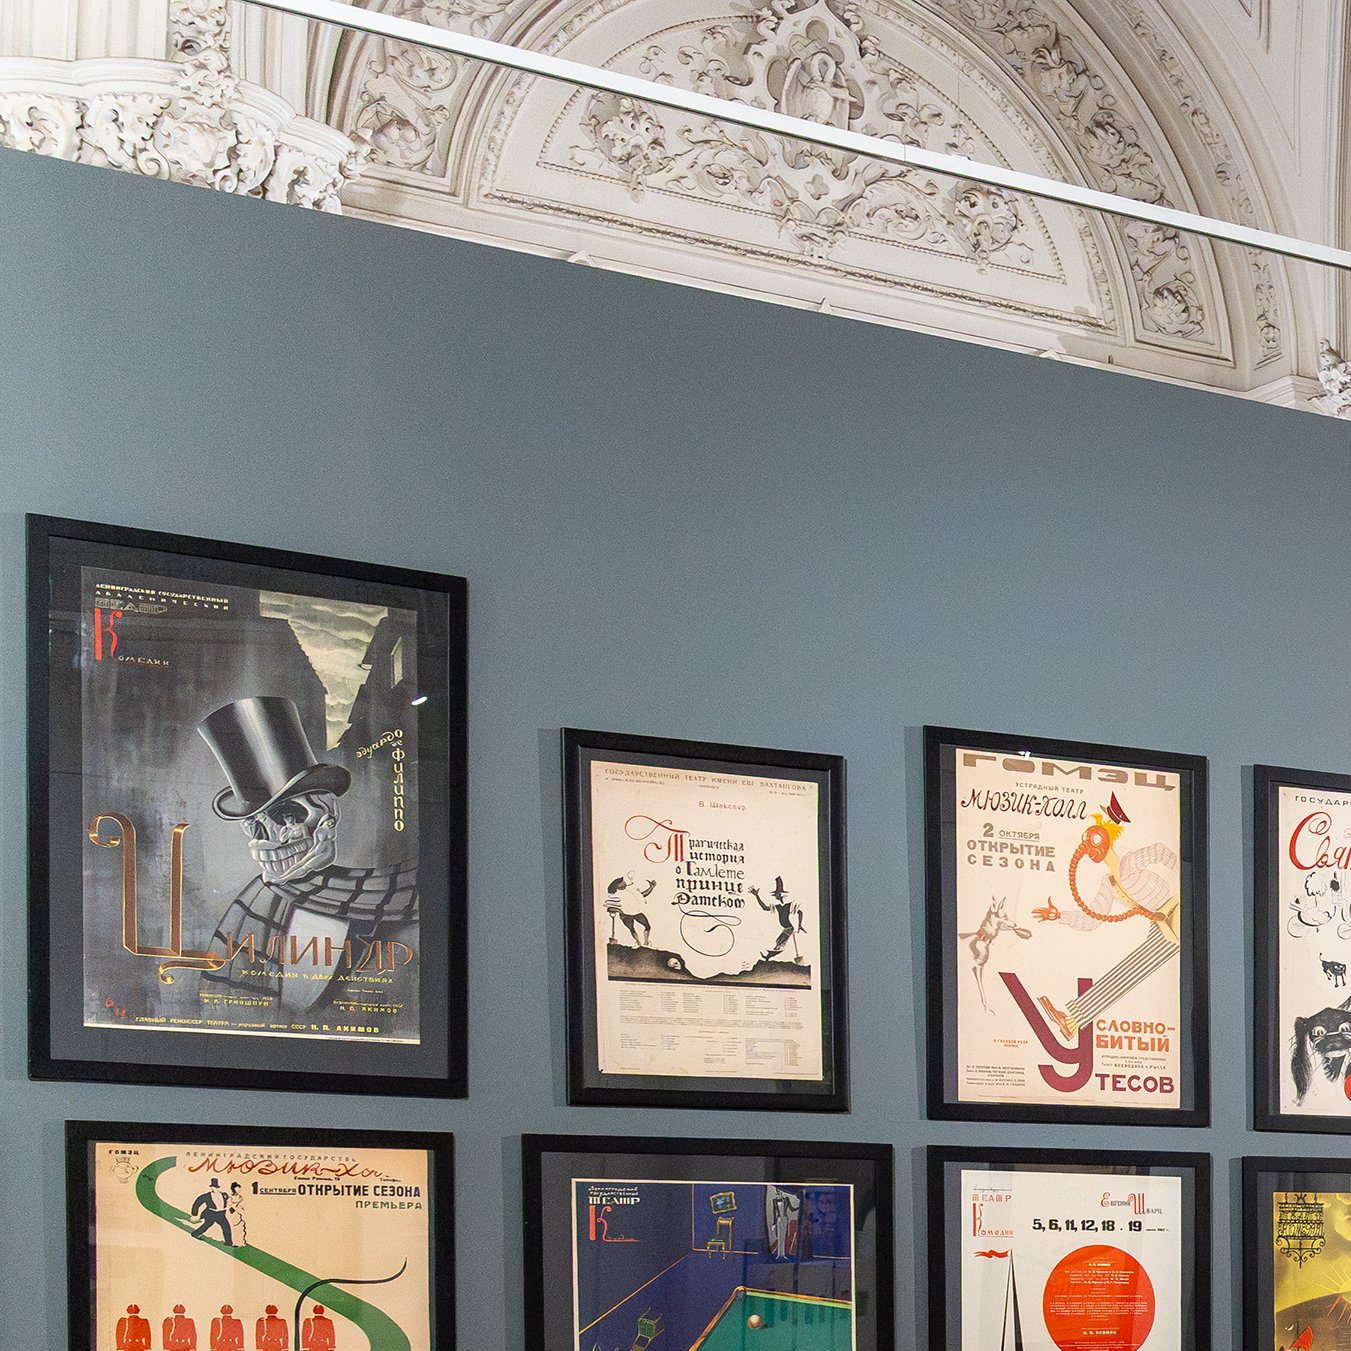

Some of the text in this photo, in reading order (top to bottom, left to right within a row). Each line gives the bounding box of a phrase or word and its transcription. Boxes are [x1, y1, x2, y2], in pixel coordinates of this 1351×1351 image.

[962, 753, 1176, 792] ГОМЭЦ
[982, 822, 1040, 842] 2 ОКТЯБРЯ
[966, 839, 1056, 859] ОТКРЫТИЕ
[967, 853, 1056, 873] СЕЗОНА
[336, 1025, 380, 1034] АКИМОВ
[1095, 1034, 1170, 1053] БИТЫЙ
[1095, 1073, 1175, 1094] ТЕСОВ
[252, 1181, 258, 1195] 1
[298, 1184, 369, 1197] ОТКРЫТИЕ
[373, 1185, 421, 1198] СЕЗОНА
[355, 1200, 422, 1210] ПРЕМЬЕРА
[1032, 1218, 1046, 1232] 5,
[1048, 1219, 1062, 1232] 6,
[1064, 1219, 1078, 1232] 11,
[1080, 1219, 1099, 1233] 12,
[1127, 1220, 1143, 1232] 19
